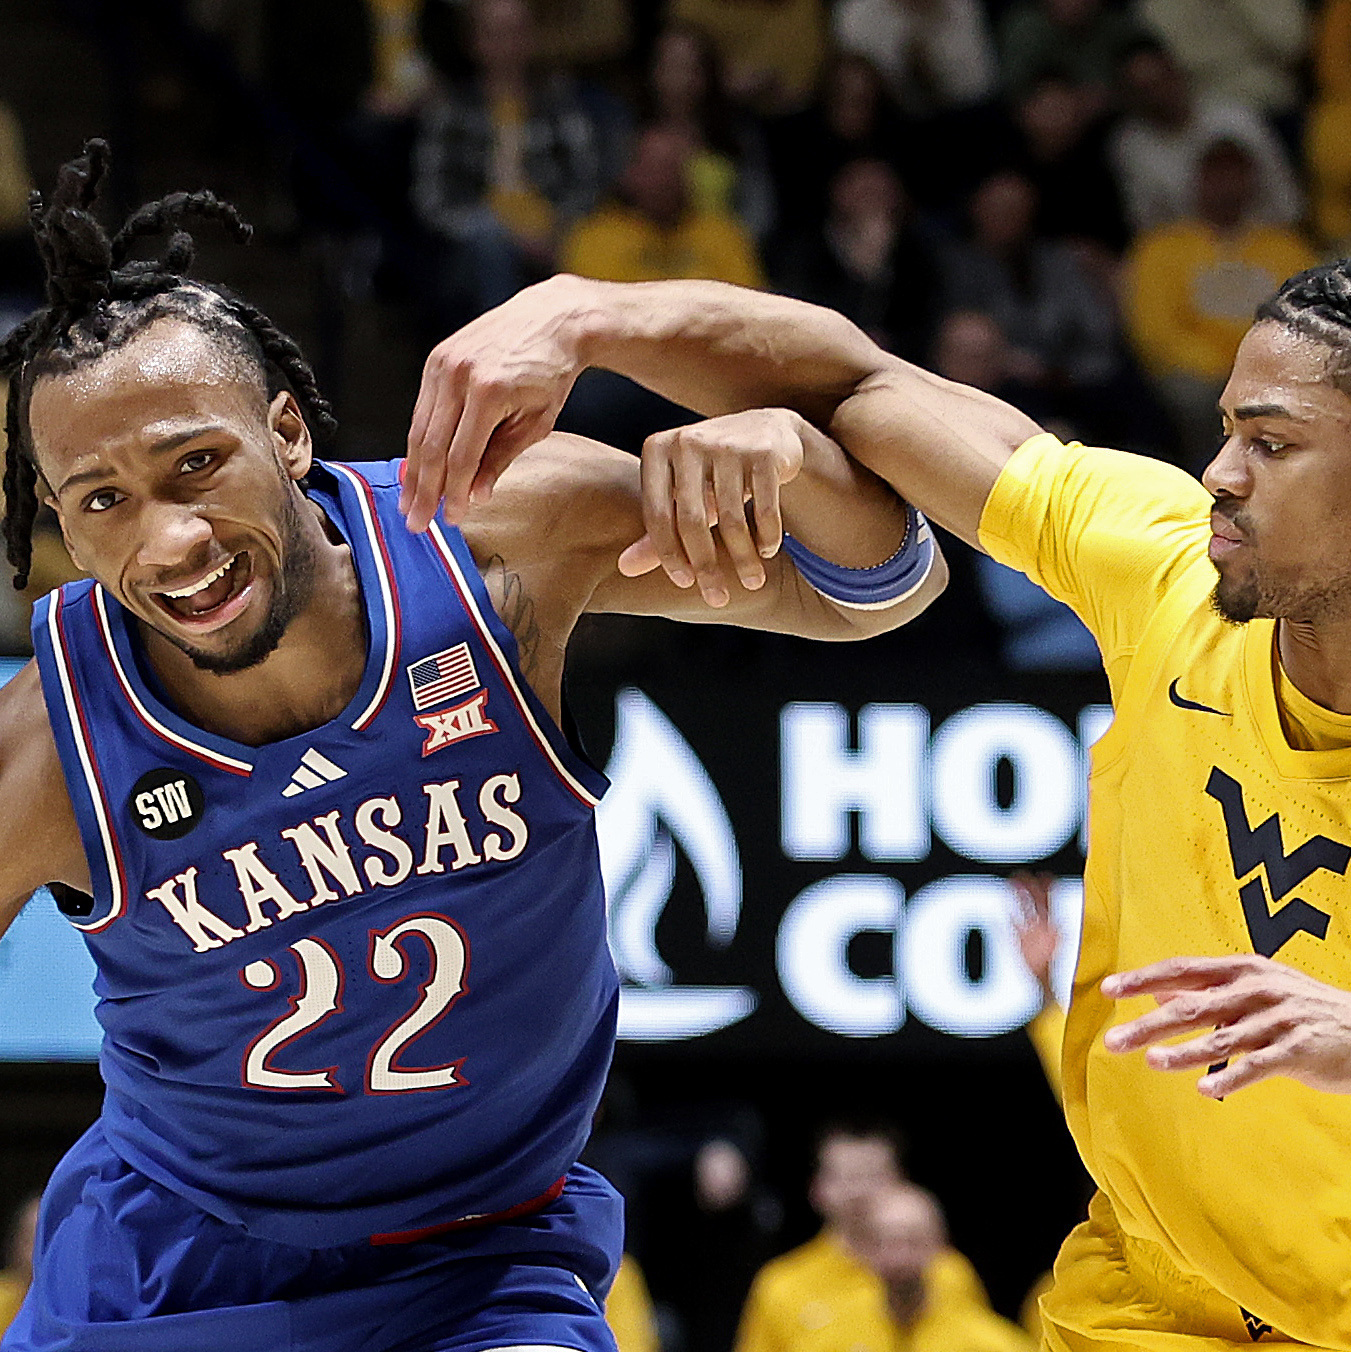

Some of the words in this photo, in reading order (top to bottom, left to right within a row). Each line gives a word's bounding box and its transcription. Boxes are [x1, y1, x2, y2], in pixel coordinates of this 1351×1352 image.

[134, 779, 194, 831] SW
[146, 772, 531, 954] KANSAS
[239, 911, 471, 1095] 22
